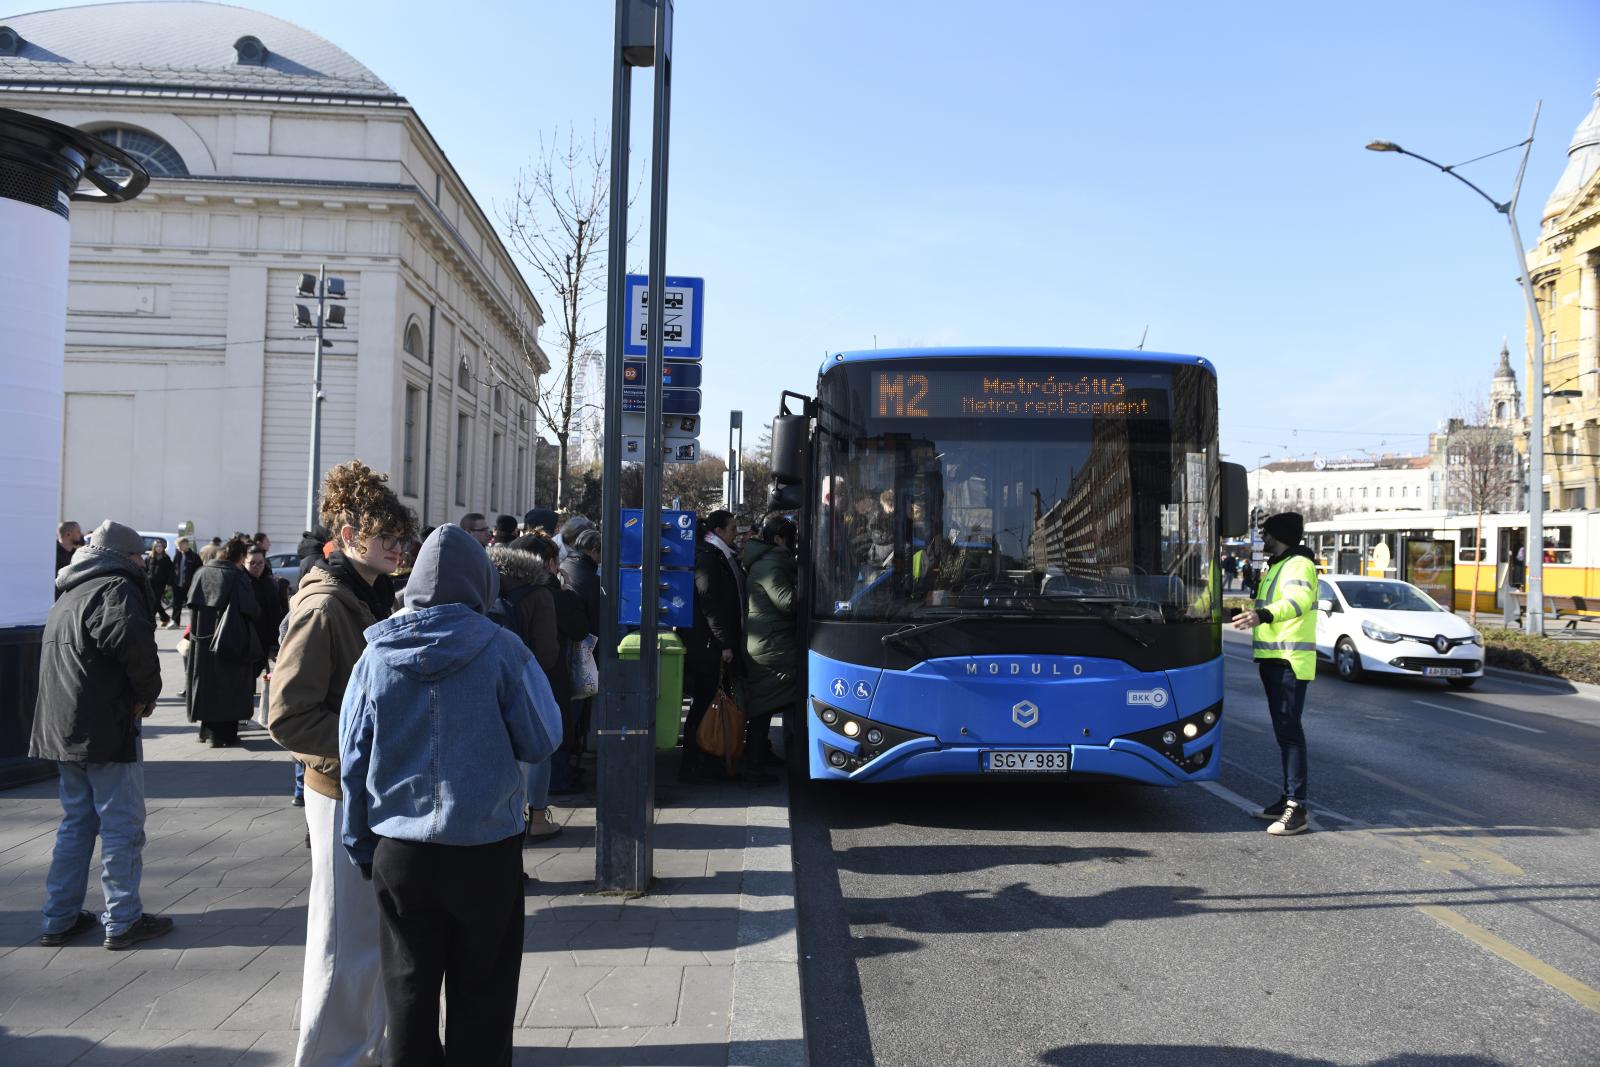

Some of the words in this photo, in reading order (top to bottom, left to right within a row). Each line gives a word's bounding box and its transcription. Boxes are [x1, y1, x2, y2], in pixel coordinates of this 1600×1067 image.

[625, 370, 637, 378] D2
[983, 376, 1126, 396] Metrópótló
[879, 374, 929, 417] M2
[961, 396, 1019, 413] Metro
[1024, 398, 1149, 415] replacement
[966, 663, 1083, 676] MODULO
[1132, 693, 1150, 703] BKK
[993, 753, 1066, 769] SGY-983
